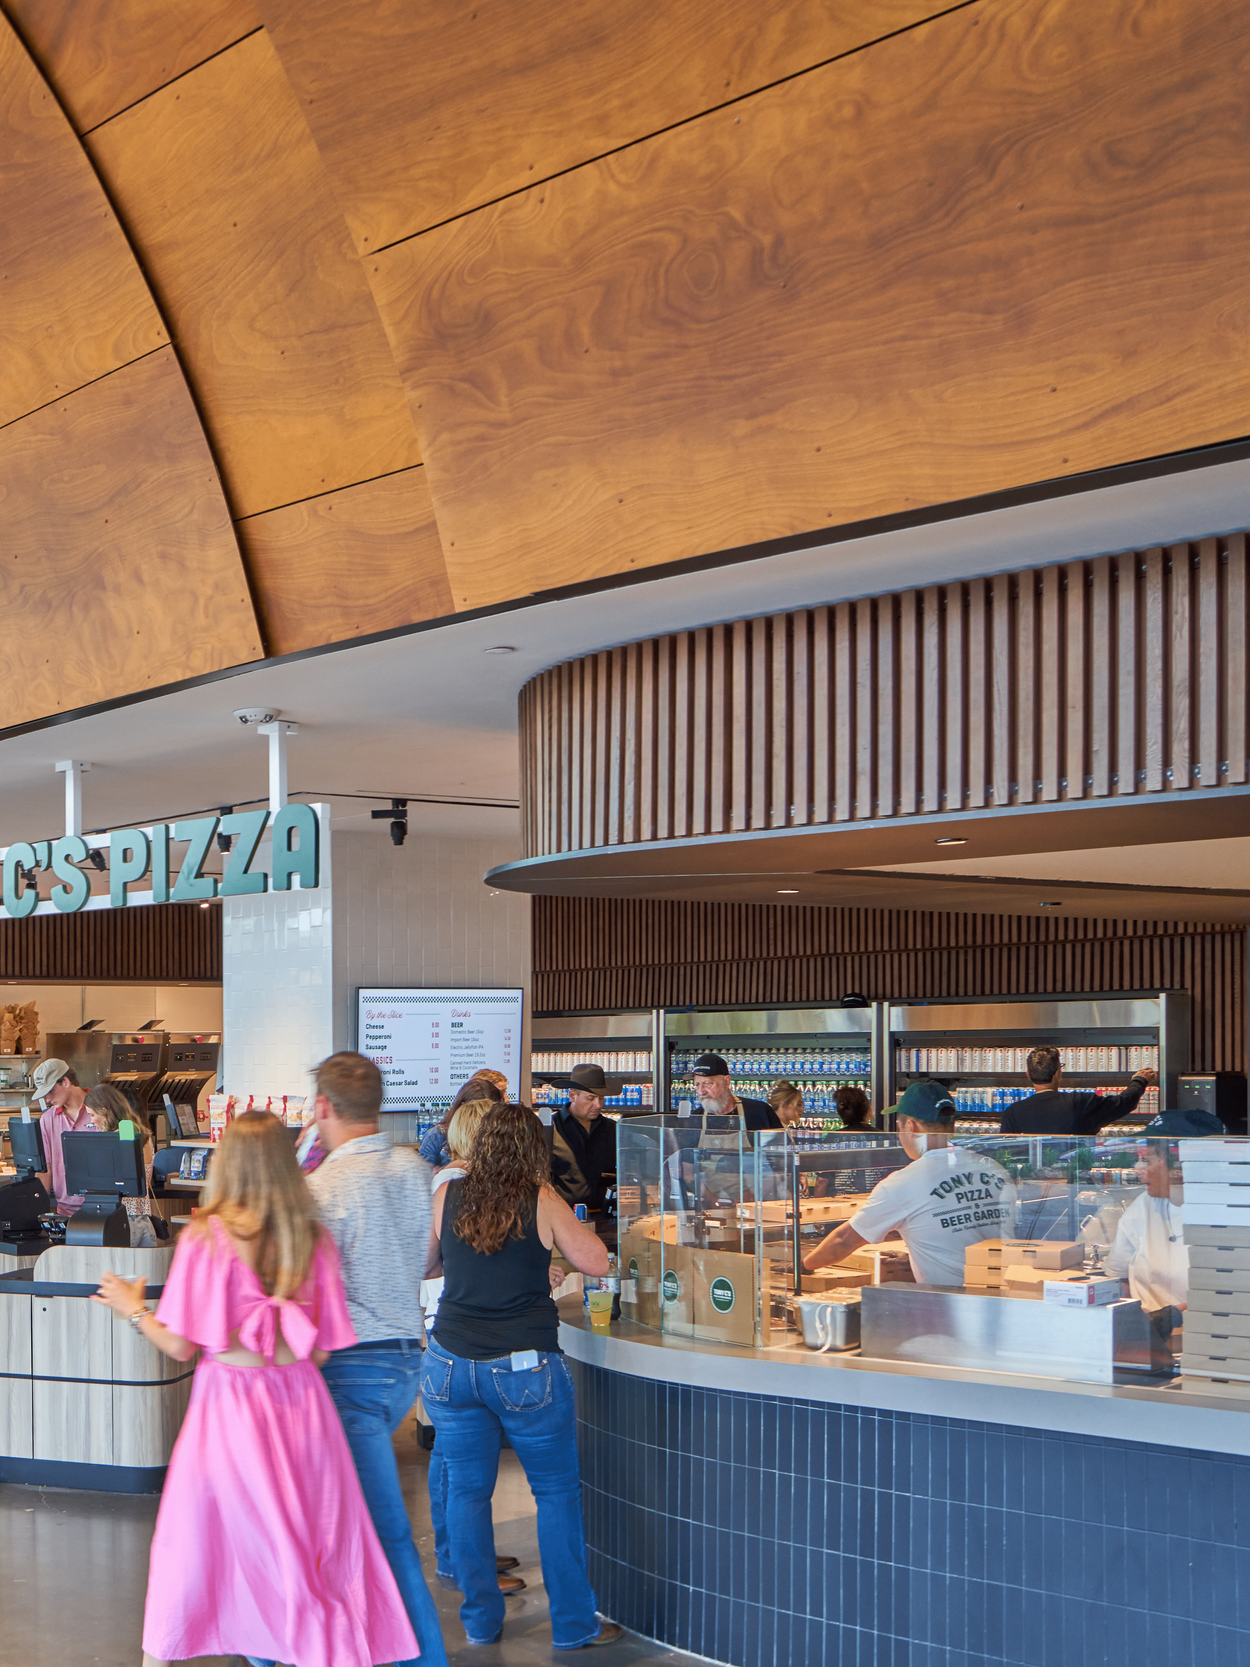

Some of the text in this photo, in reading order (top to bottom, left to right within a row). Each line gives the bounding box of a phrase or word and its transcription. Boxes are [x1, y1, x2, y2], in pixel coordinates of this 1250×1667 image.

[2, 835, 90, 918] C'S
[110, 803, 320, 907] PIZZA
[451, 1009, 471, 1018] Drinks
[929, 1172, 974, 1200] TONY
[955, 1188, 993, 1204] PIZZA
[940, 1208, 1010, 1228] BEER GARDEN
